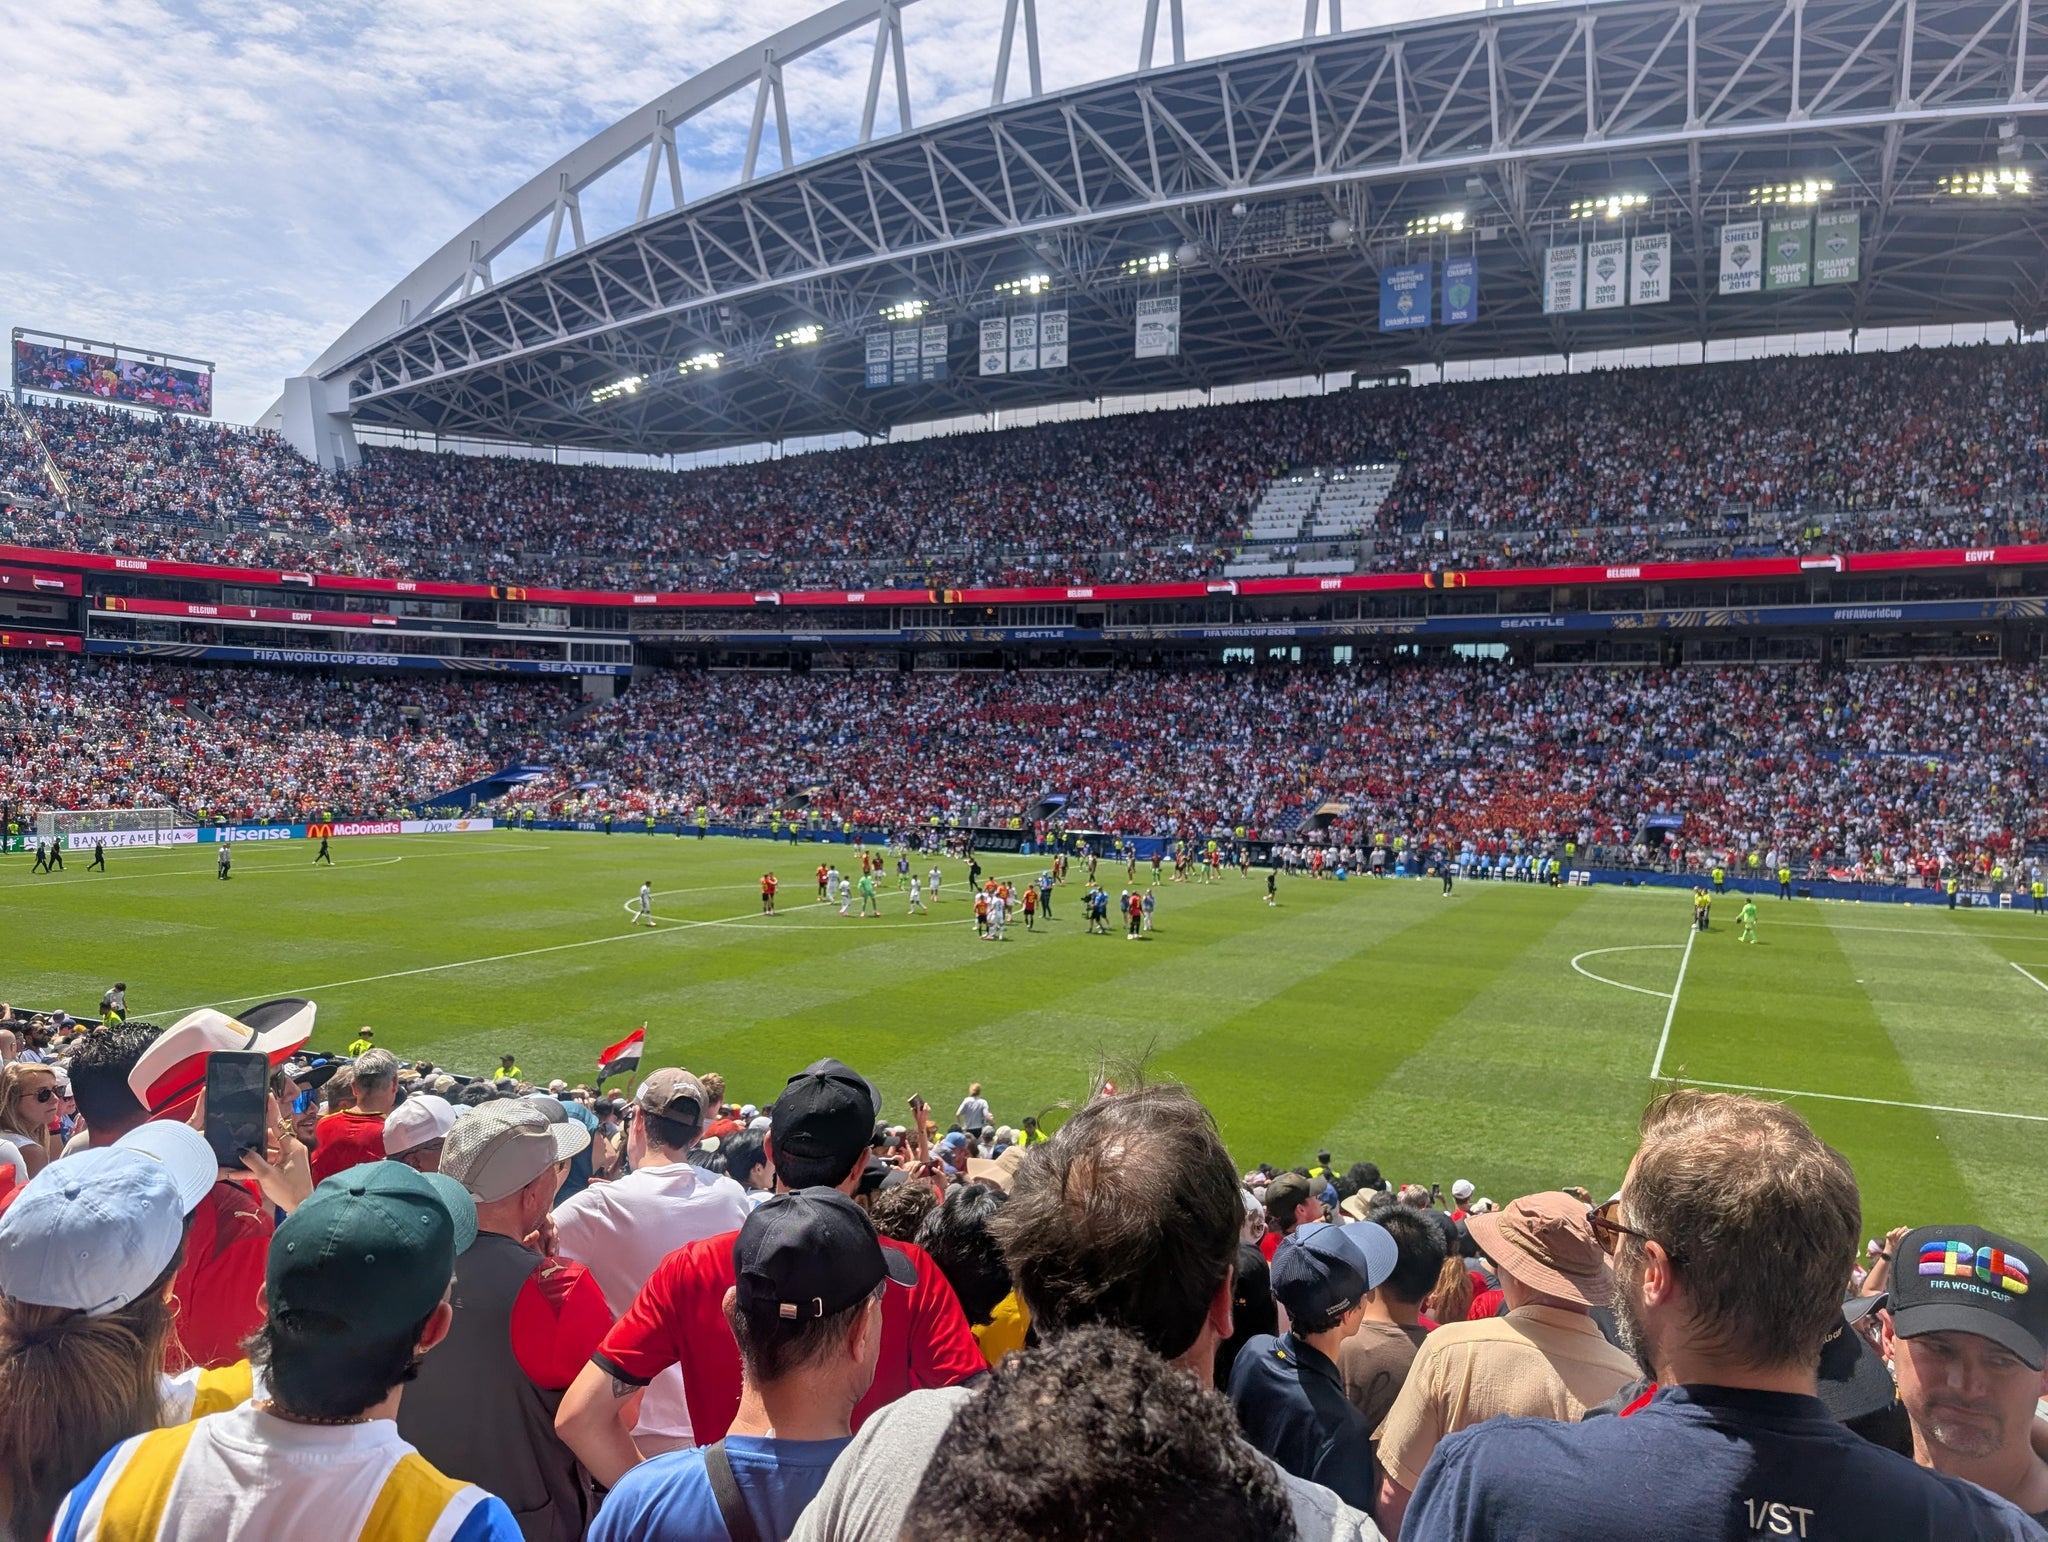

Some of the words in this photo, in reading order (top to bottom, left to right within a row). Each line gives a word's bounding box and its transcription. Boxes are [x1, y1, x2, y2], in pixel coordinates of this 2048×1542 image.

[1839, 214, 1858, 224] CUP
[1770, 222, 1788, 232] MLS
[1791, 219, 1809, 230] CUP
[1724, 231, 1759, 243] SHIELD
[1769, 262, 1807, 275] CHAMPS
[1817, 257, 1856, 270] CHAMPS
[1721, 270, 1760, 282] CHAMPS
[1640, 280, 1660, 290] 2011
[1729, 280, 1751, 290] 2014
[1965, 550, 1995, 562] EGYPT
[115, 560, 147, 570] BELGIUM
[1606, 568, 1640, 579] BELGIUM
[397, 582, 416, 591] EGYPT
[1320, 579, 1341, 589] EGYPT
[188, 605, 218, 615] BELGIUM
[250, 609, 257, 618] V
[292, 612, 312, 621] EGYPT
[1834, 608, 1902, 619] #FIFAWorldCup
[1500, 618, 1565, 628] SEATTLE
[1221, 629, 1250, 637] WORLD
[1267, 628, 1296, 636] 2026
[253, 650, 281, 660] FIFA
[282, 652, 329, 663] WORLD
[330, 654, 355, 664] CUP
[356, 656, 399, 666] 2026
[538, 663, 616, 674] SEATTLE
[333, 822, 400, 836] McDonald's
[424, 821, 452, 832] Dove
[578, 822, 596, 830] FIFA
[73, 836, 107, 846] BANK
[111, 834, 127, 844] OF
[215, 827, 291, 842] Hisense
[1930, 1280, 1950, 1289] FIFA
[1951, 1281, 1989, 1296] WORLD
[1743, 1498, 1815, 1538] 1/ST
